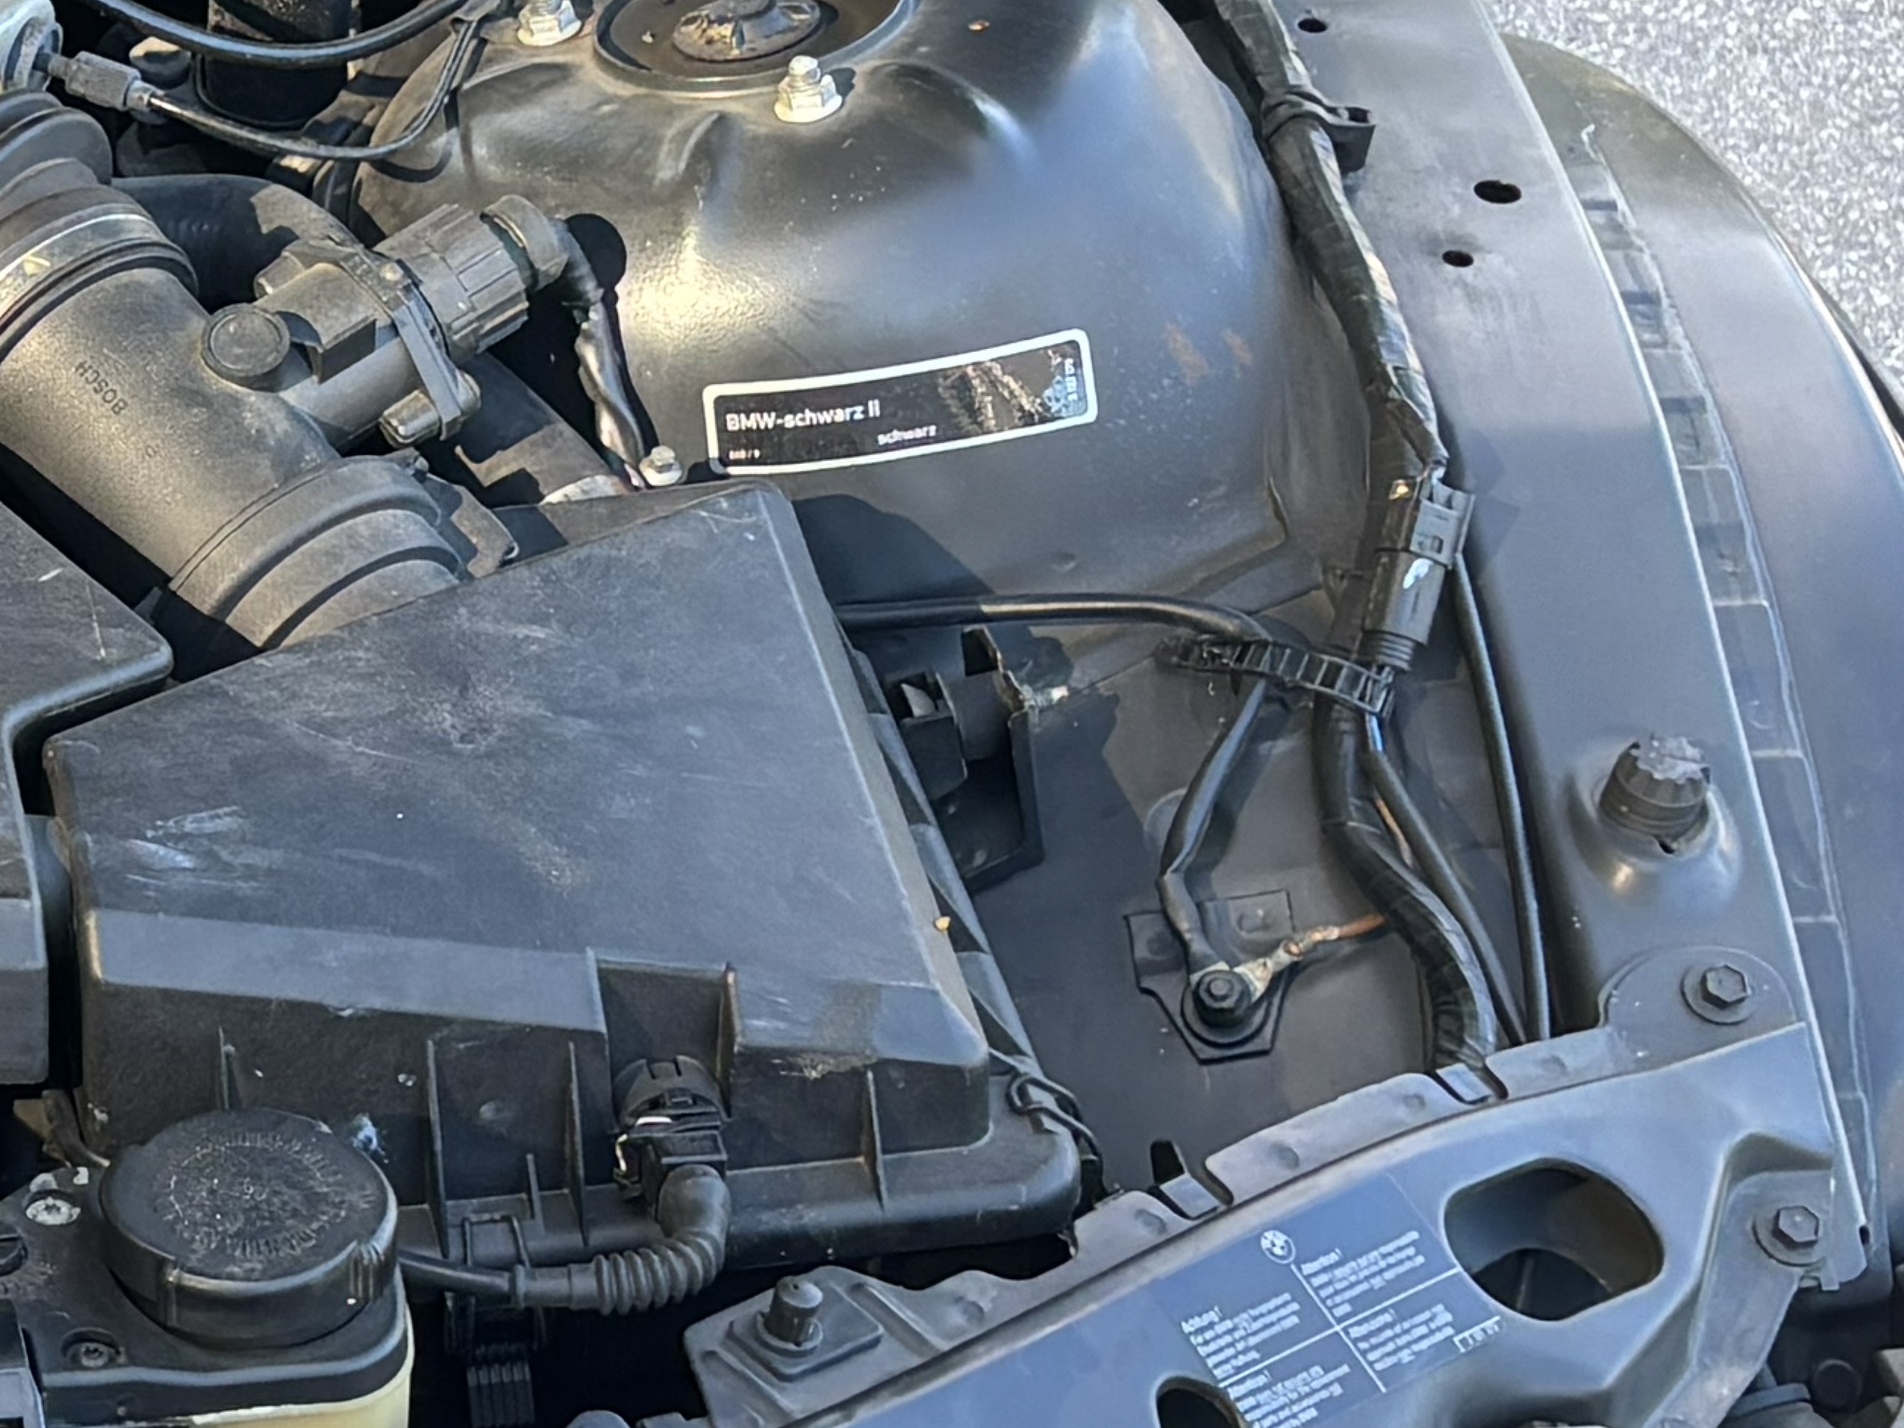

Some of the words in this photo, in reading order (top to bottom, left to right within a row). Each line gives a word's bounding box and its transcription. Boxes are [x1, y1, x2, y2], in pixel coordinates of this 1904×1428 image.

[75, 359, 128, 415] BOSCH
[725, 402, 865, 433] BMW-schwarz
[877, 424, 937, 445] schwarz
